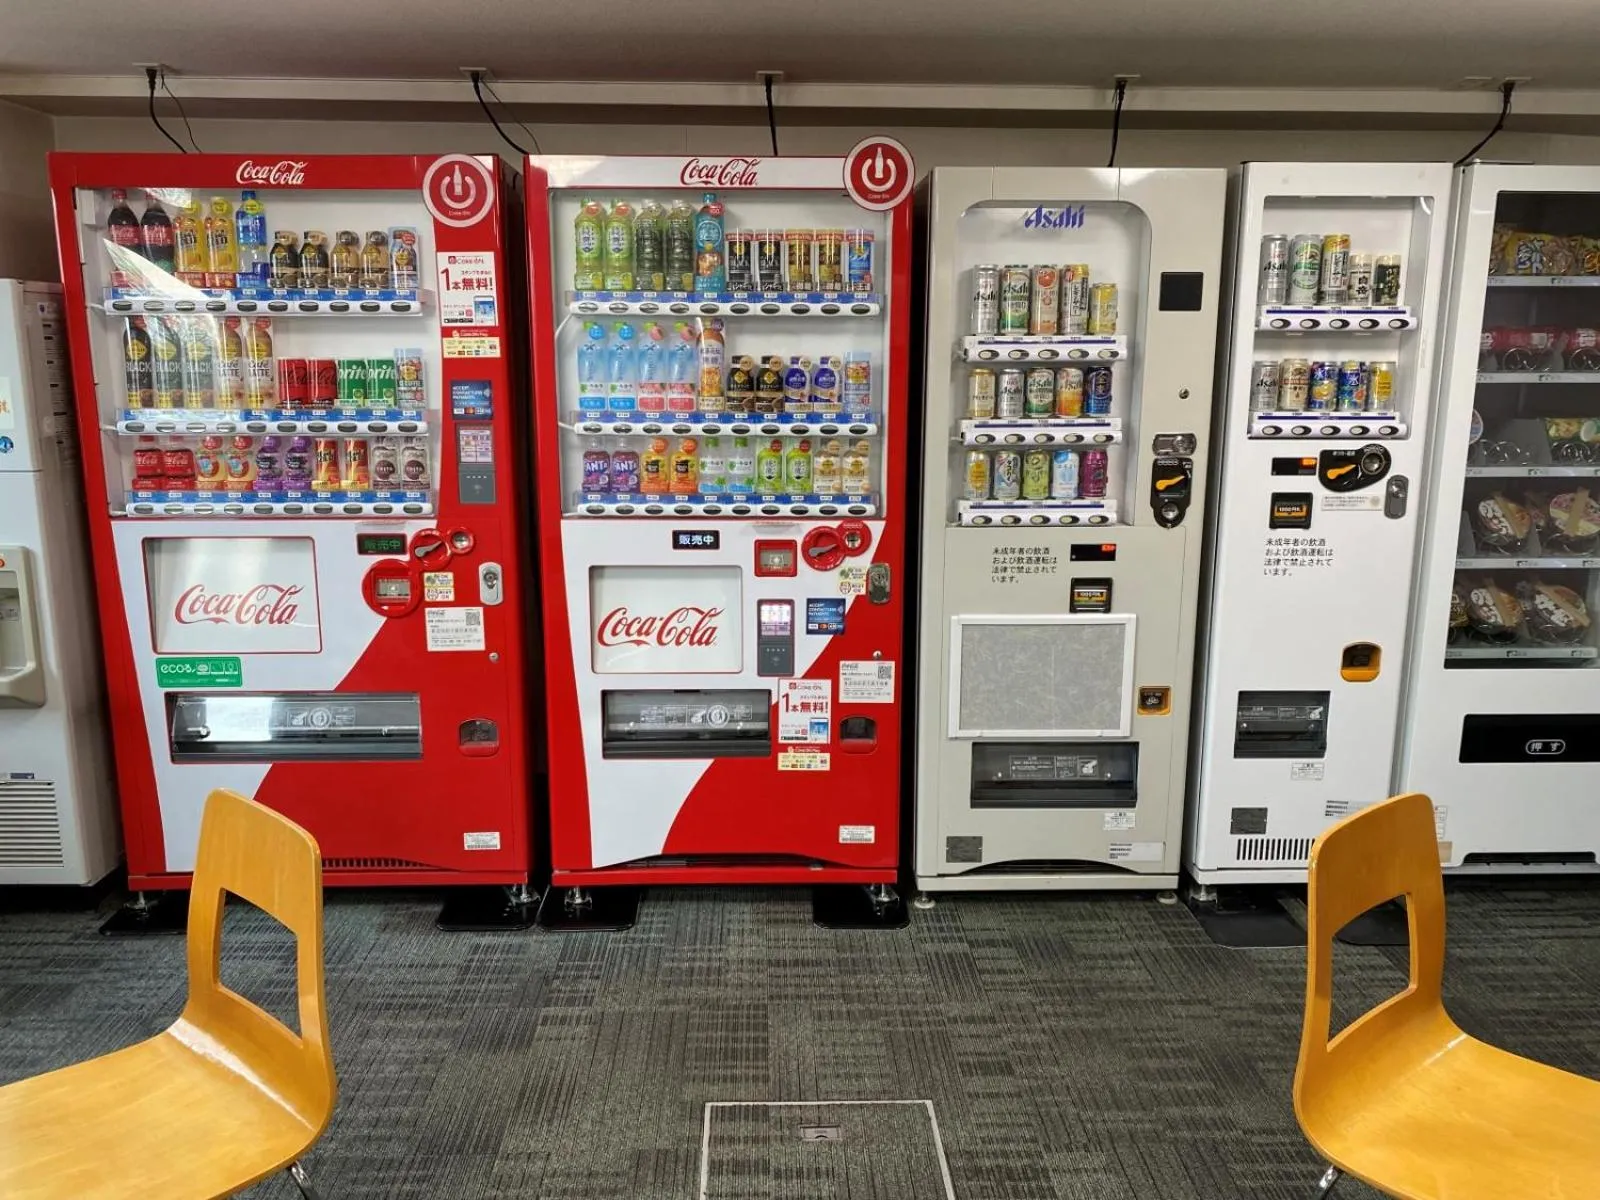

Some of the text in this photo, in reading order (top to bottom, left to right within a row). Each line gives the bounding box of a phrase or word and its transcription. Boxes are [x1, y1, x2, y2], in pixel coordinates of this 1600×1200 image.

[236, 160, 308, 185] Coca-Cola
[680, 158, 761, 186] Coca-Cola
[1024, 204, 1085, 229] Asahi
[679, 535, 714, 545] 販売中
[1265, 538, 1326, 546] 未成年者の飲酒
[992, 547, 1050, 555] 未成年者の飲酒
[1265, 548, 1333, 557] および飲酒運転は
[992, 556, 1057, 565] および飲酒運転は
[1264, 558, 1333, 567] 法律で禁止されて
[991, 565, 1057, 573] 法律で禁止されて
[175, 584, 305, 624] Coca-Cola
[598, 607, 725, 647] Coca-Cola
